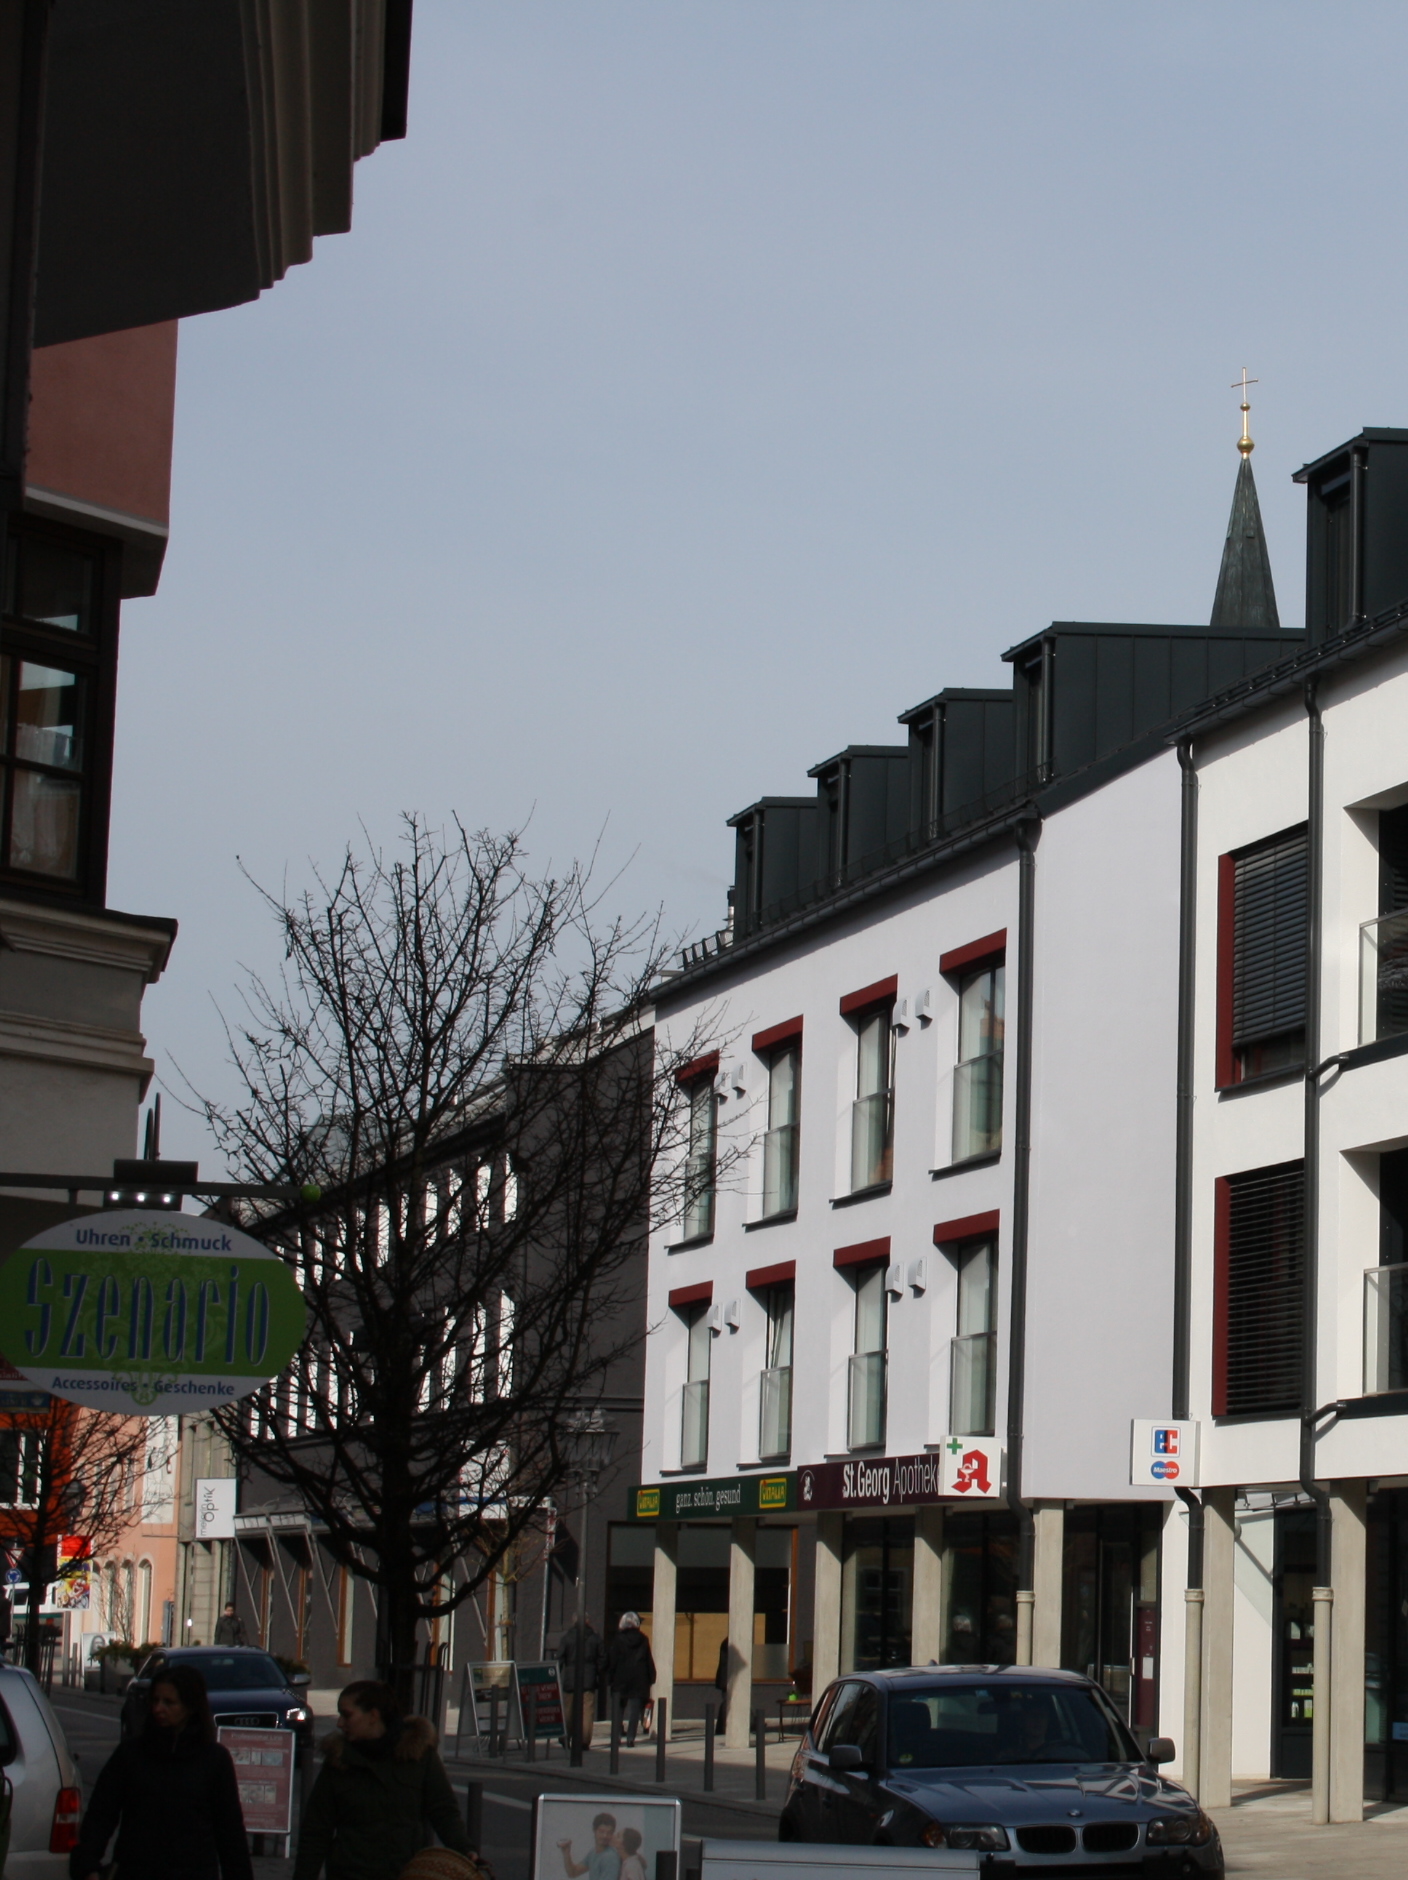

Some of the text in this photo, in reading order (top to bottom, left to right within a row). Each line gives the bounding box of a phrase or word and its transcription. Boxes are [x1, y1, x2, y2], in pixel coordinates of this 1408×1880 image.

[76, 1229, 233, 1252] Uhren Schmuck
[25, 1257, 271, 1367] Szenario
[52, 1376, 235, 1397] Accessoires Geschenke
[1153, 1466, 1178, 1474] Maestro
[716, 1483, 741, 1512] gesund
